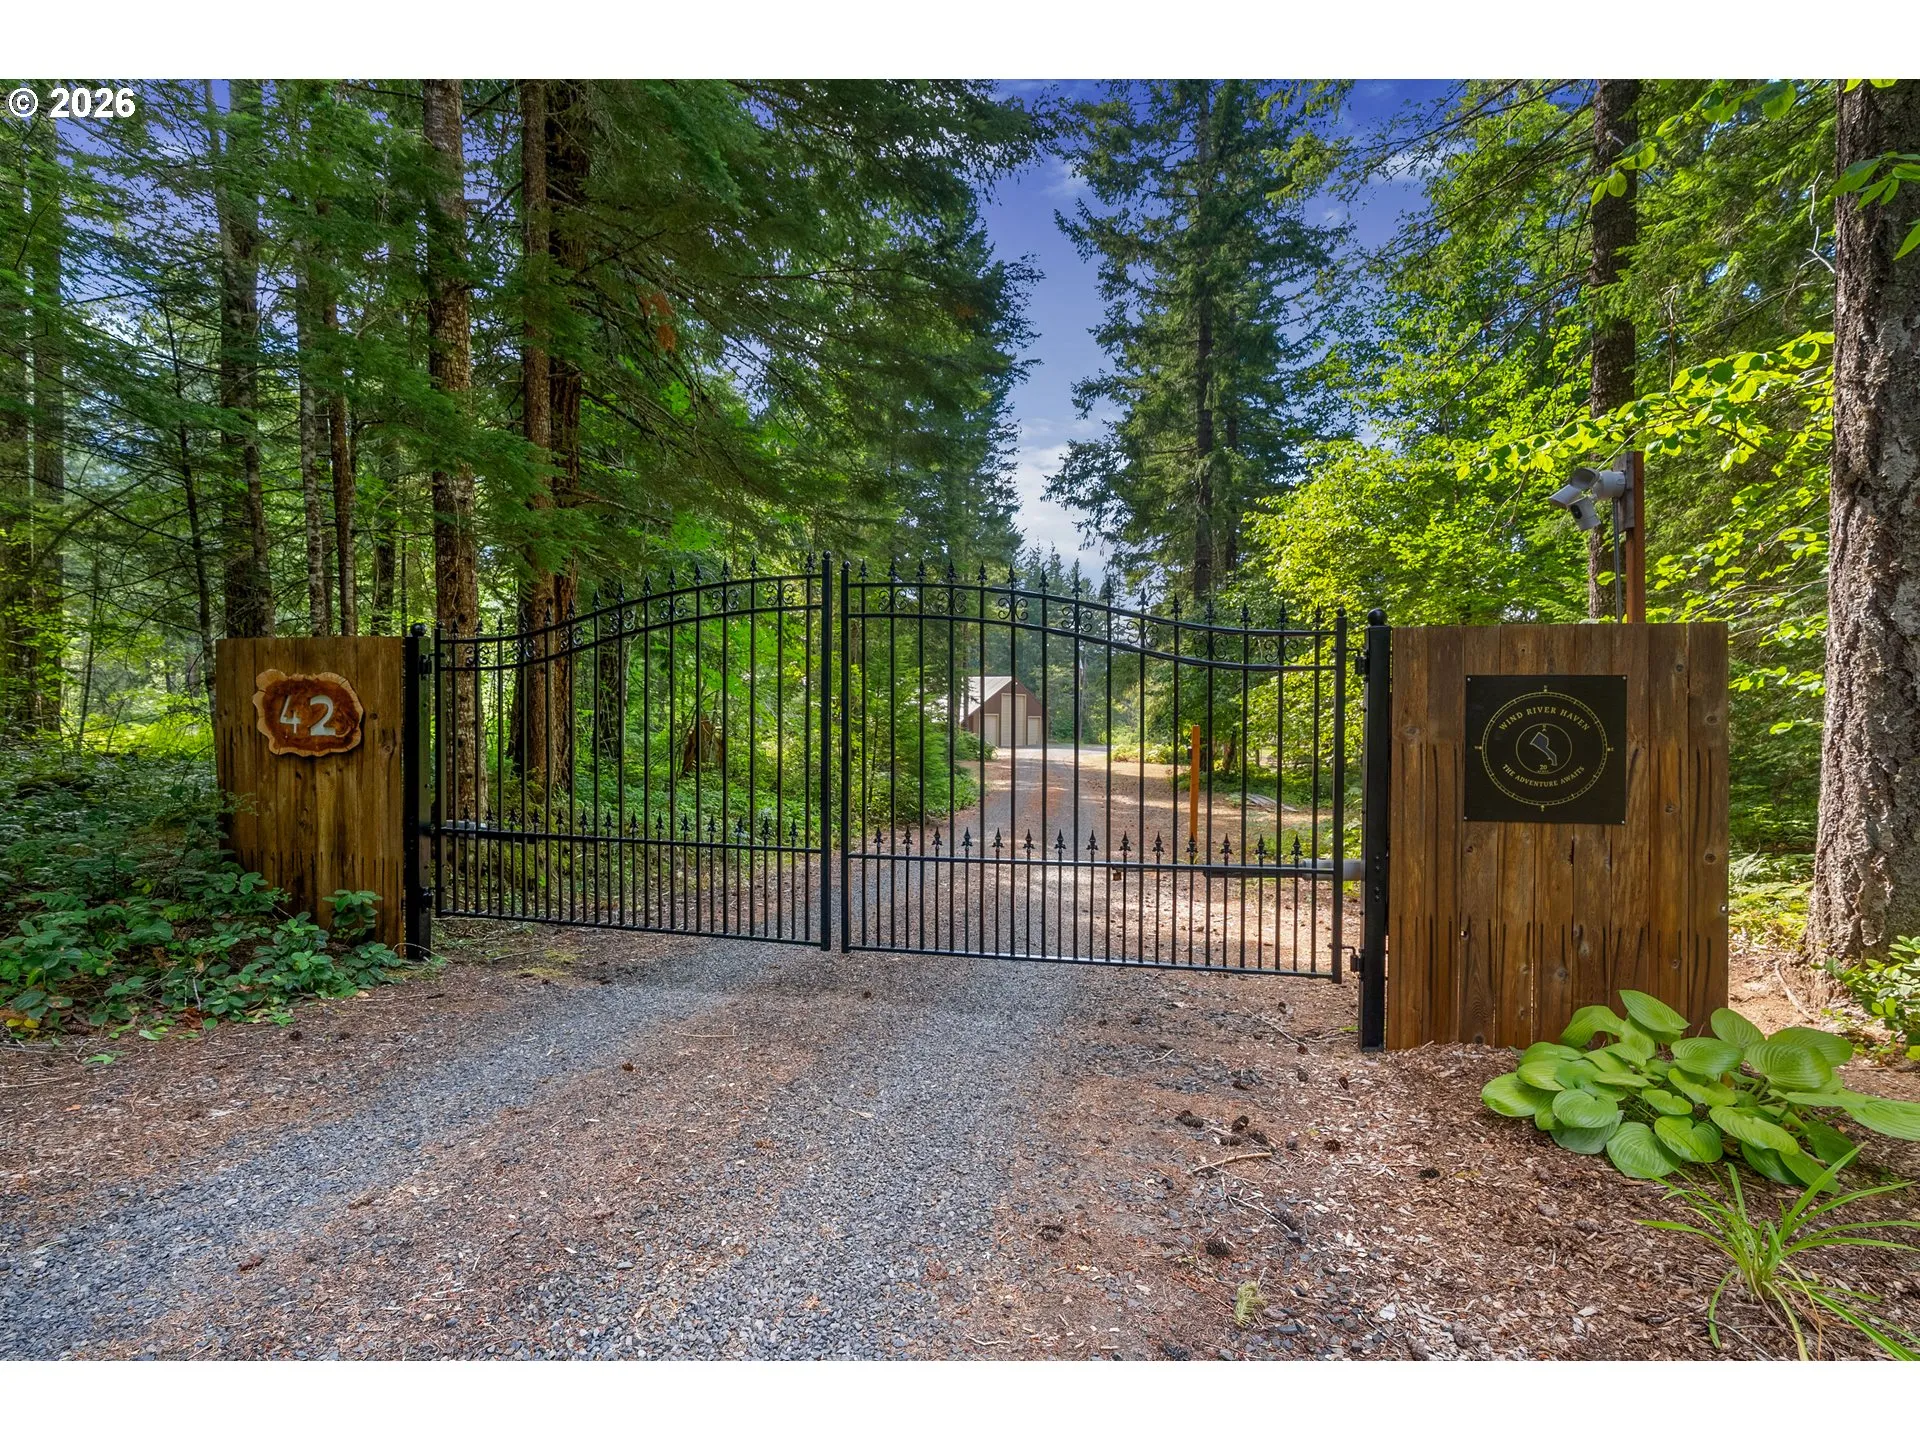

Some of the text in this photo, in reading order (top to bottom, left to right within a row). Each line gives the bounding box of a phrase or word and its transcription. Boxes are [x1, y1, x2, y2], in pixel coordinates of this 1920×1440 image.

[279, 695, 337, 737] 42
[1498, 706, 1591, 732] WIND RIVER HAVEN
[1502, 763, 1585, 788] THE ADVENTURE AWAITS
